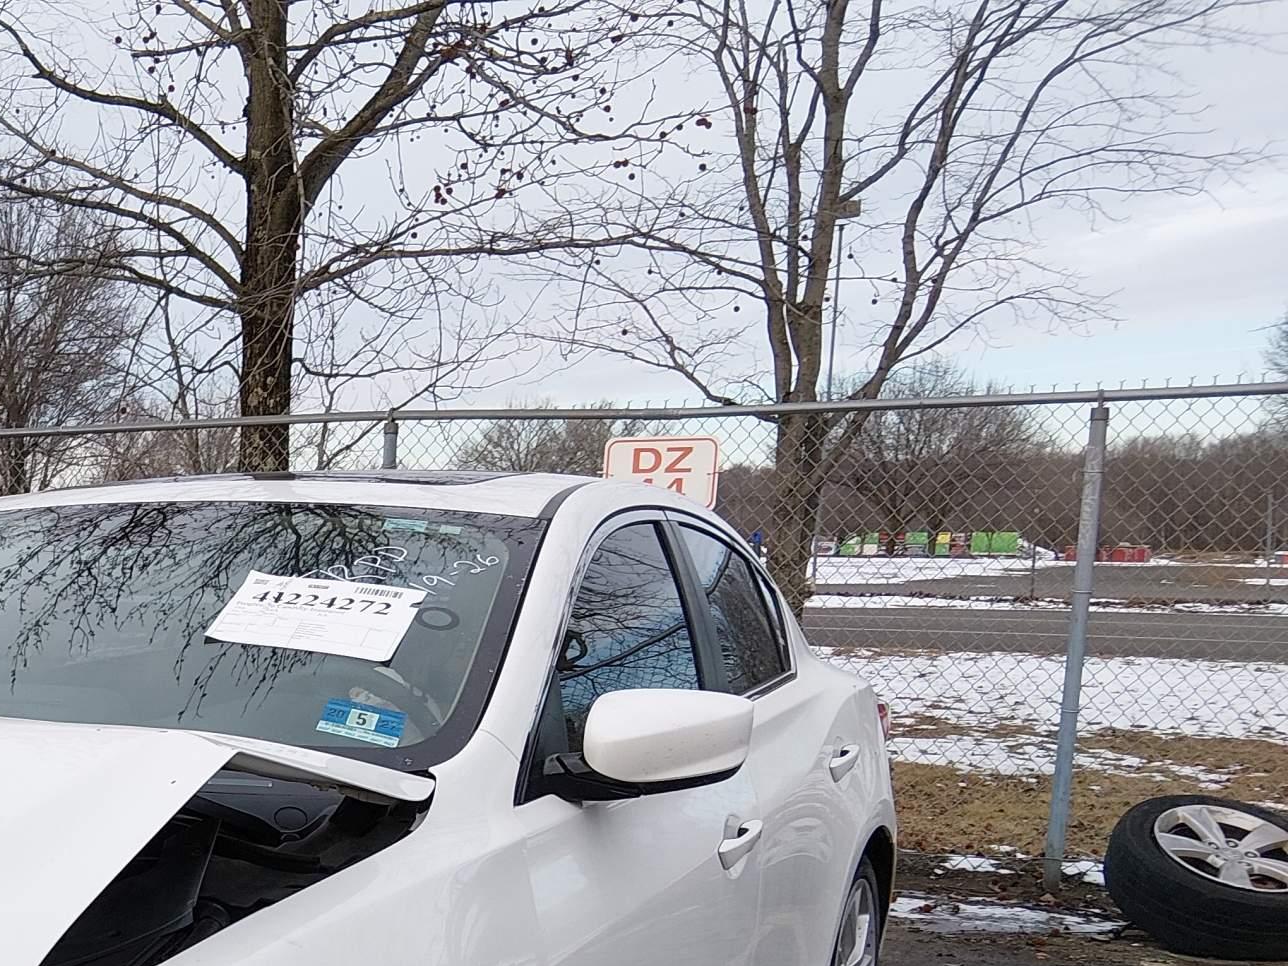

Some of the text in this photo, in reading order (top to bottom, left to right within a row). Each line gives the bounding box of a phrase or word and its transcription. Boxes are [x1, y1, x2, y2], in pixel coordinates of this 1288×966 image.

[631, 446, 694, 474] DZ
[642, 477, 686, 496] 4
[327, 707, 345, 719] 20
[355, 712, 369, 726] 5
